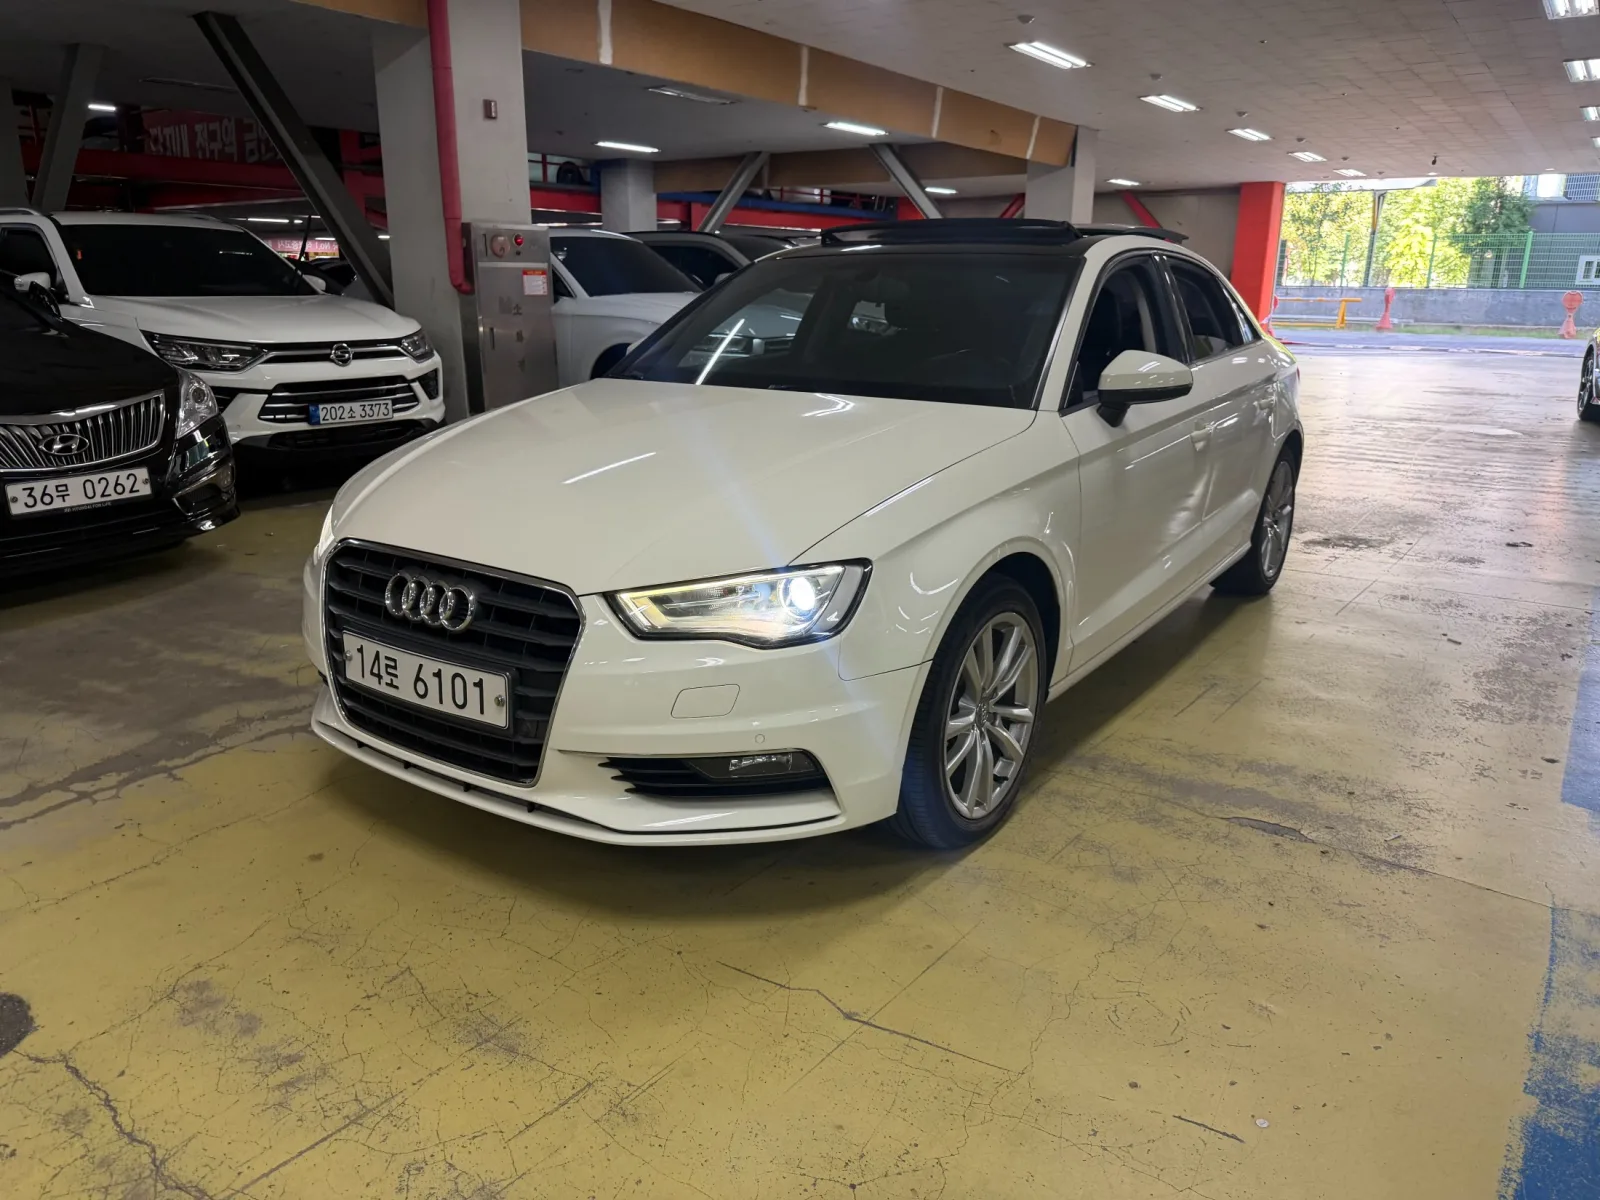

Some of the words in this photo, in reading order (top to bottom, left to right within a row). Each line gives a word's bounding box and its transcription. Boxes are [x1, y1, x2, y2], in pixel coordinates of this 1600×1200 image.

[321, 405, 356, 421] 202소
[359, 402, 390, 418] 3373
[22, 483, 70, 509] 36무
[83, 473, 140, 500] 0262
[357, 644, 400, 690] 14로
[413, 663, 484, 715] 6101
